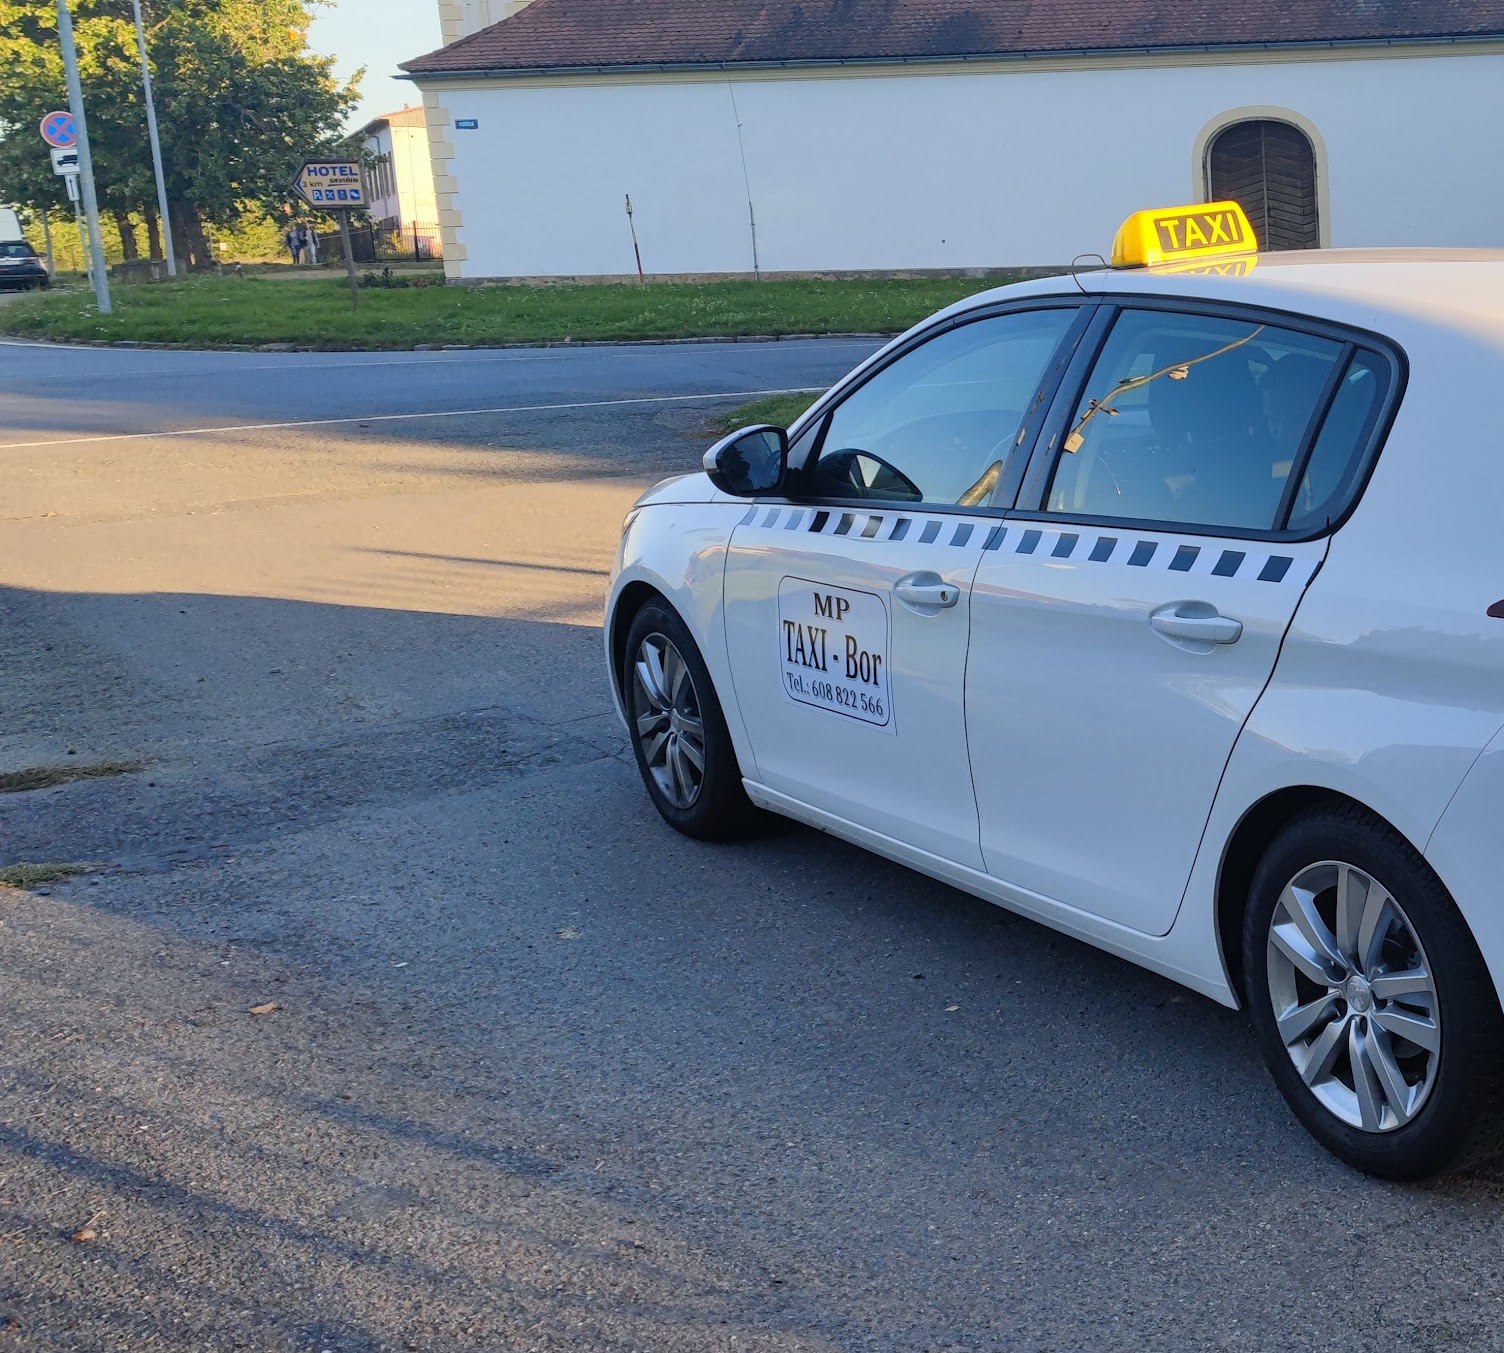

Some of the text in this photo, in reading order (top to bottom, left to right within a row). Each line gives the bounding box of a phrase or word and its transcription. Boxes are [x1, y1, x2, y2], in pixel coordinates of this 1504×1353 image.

[307, 166, 358, 176] HOTEL
[1159, 212, 1239, 249] TAXI
[813, 592, 850, 620] MP
[783, 619, 828, 672] TAXI
[845, 634, 882, 686] Bor
[786, 671, 883, 716] Tel.: 608 822 566
